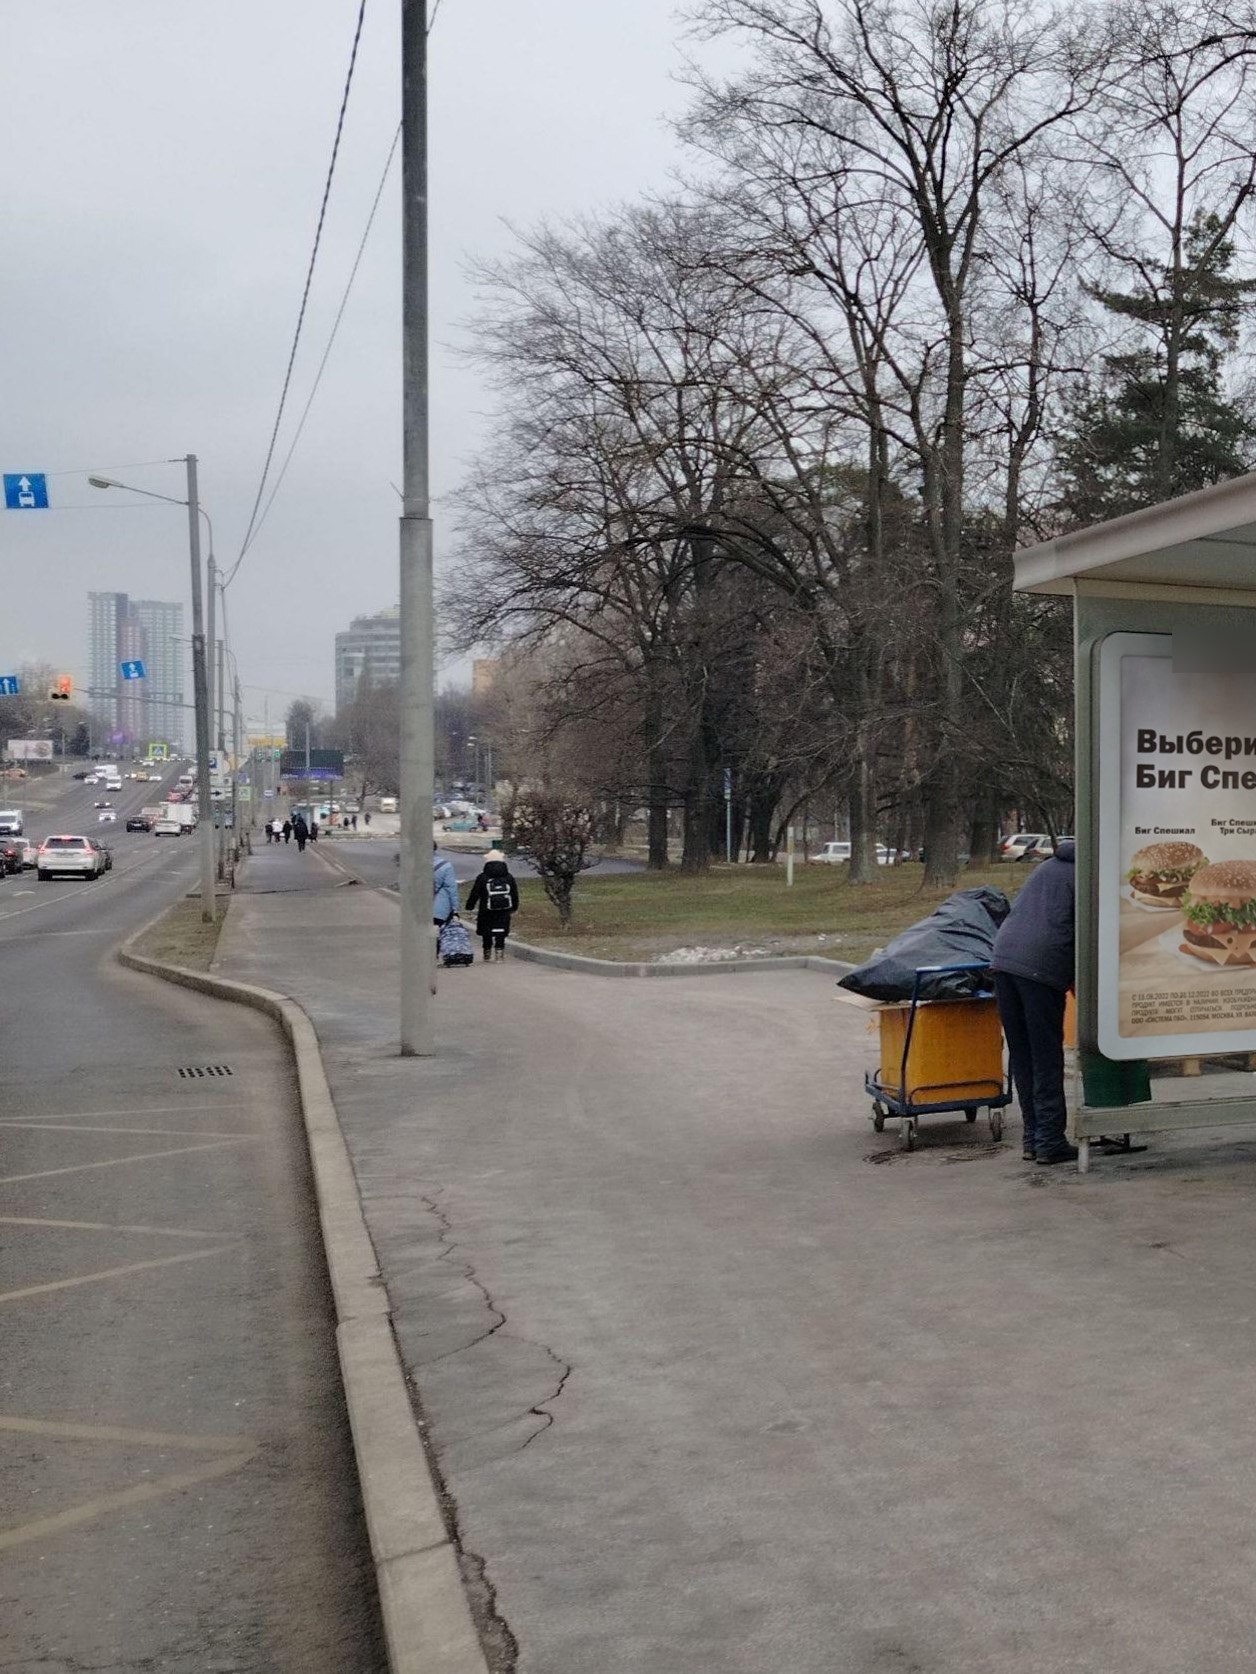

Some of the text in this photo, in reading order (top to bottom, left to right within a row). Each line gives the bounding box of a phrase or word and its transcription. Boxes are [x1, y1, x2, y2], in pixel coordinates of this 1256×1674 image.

[1136, 764, 1193, 789] Биг
[1135, 827, 1196, 835] Биг Спешиал
[1219, 827, 1235, 836] Три
